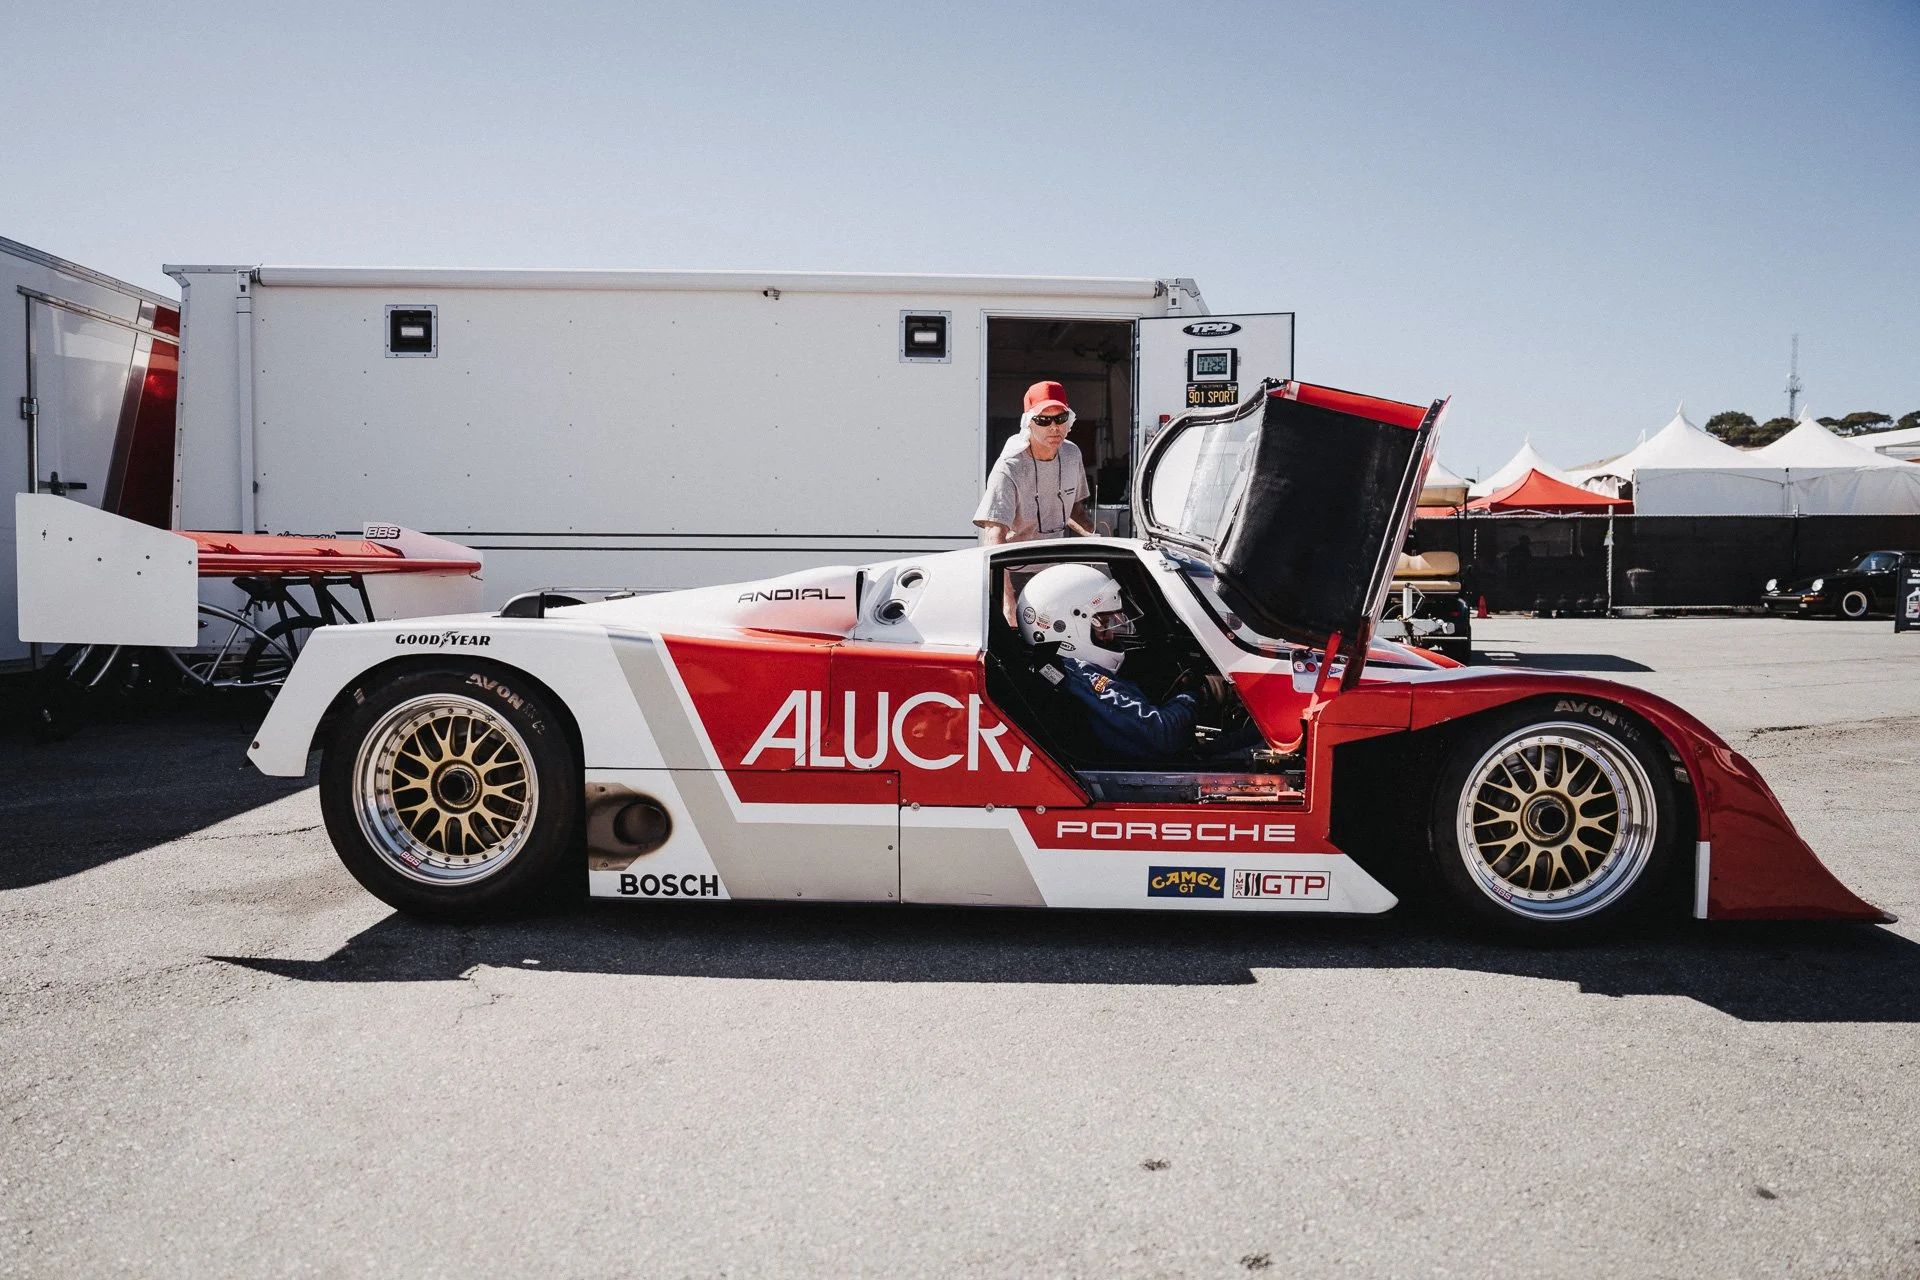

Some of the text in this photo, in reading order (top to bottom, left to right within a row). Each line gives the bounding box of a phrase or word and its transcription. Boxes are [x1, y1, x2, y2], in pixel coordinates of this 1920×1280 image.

[1191, 323, 1233, 333] TPD
[1188, 390, 1236, 404] 901 SPORT
[365, 527, 400, 540] BBS
[738, 588, 846, 603] ANDIAL
[465, 673, 524, 710] AVON
[1554, 700, 1619, 725] AVON
[1056, 821, 1296, 842] PORSCHE
[400, 851, 421, 866] BBS
[620, 874, 719, 896] BOSCH
[1151, 871, 1221, 891] CAMEL
[1179, 883, 1195, 893] GT
[1262, 875, 1325, 895] GTP
[1492, 884, 1512, 900] BBS
